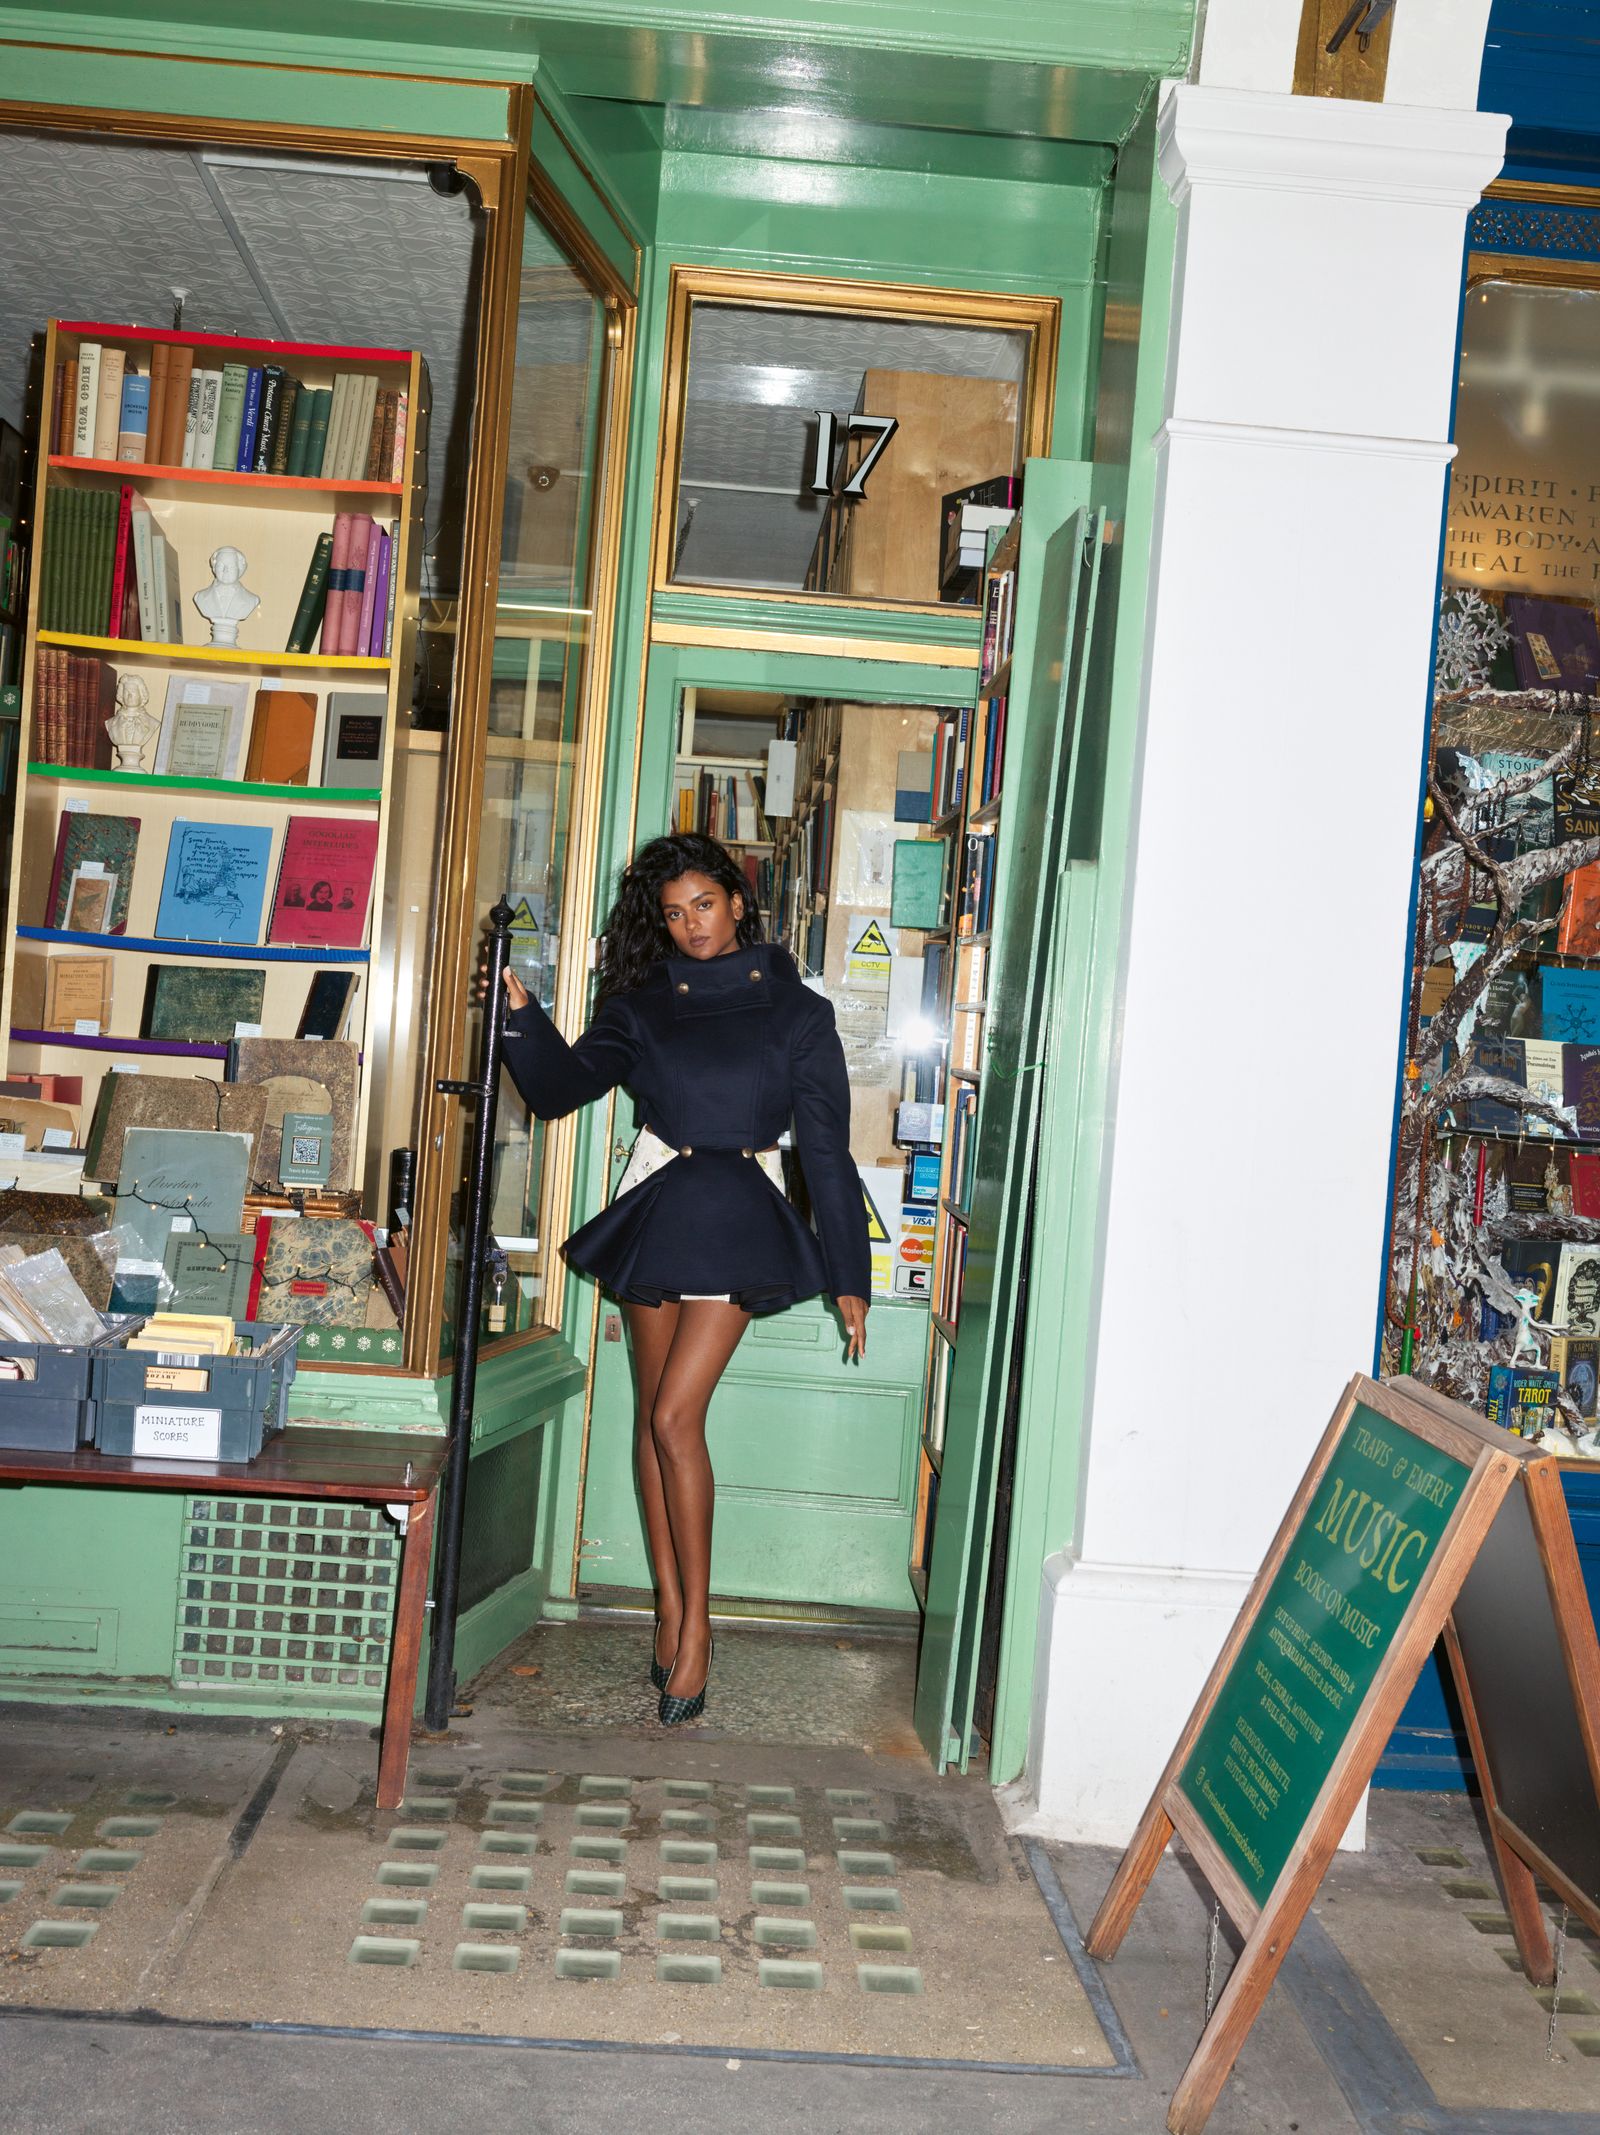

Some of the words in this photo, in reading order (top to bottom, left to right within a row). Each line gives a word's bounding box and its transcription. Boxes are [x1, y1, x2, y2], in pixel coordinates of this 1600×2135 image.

[80, 366, 91, 401] HUGO
[265, 379, 277, 413] Protestant
[77, 405, 88, 441] WOLF
[246, 407, 256, 427] Verdi
[262, 411, 273, 435] Church
[259, 434, 271, 453] Music
[809, 410, 900, 500] 17
[1454, 474, 1559, 499] SPIRIT
[1450, 500, 1578, 526] AWAKEN
[1450, 529, 1487, 544] THE
[1495, 528, 1578, 552] BODY
[1448, 550, 1529, 574] HEAL
[1540, 563, 1582, 578] THE
[861, 961, 881, 969] CCTV
[305, 1168, 320, 1176] Emery
[912, 1216, 932, 1226] VISA
[1513, 1379, 1528, 1388] RIDER
[1528, 1379, 1543, 1389] WAITE
[1519, 1388, 1552, 1404] TAROT
[141, 1415, 205, 1426] MINIATURE
[153, 1430, 189, 1442] SCORES
[1352, 1427, 1393, 1467] TRAVIS
[1392, 1457, 1408, 1479] &
[1405, 1463, 1454, 1508] EMERY
[1314, 1477, 1428, 1594] MUSIC
[1293, 1560, 1330, 1603] BOOKS
[1325, 1588, 1347, 1619] ON
[1339, 1603, 1381, 1649] MUSIC
[1268, 1626, 1305, 1670] ANTIQUARIAN
